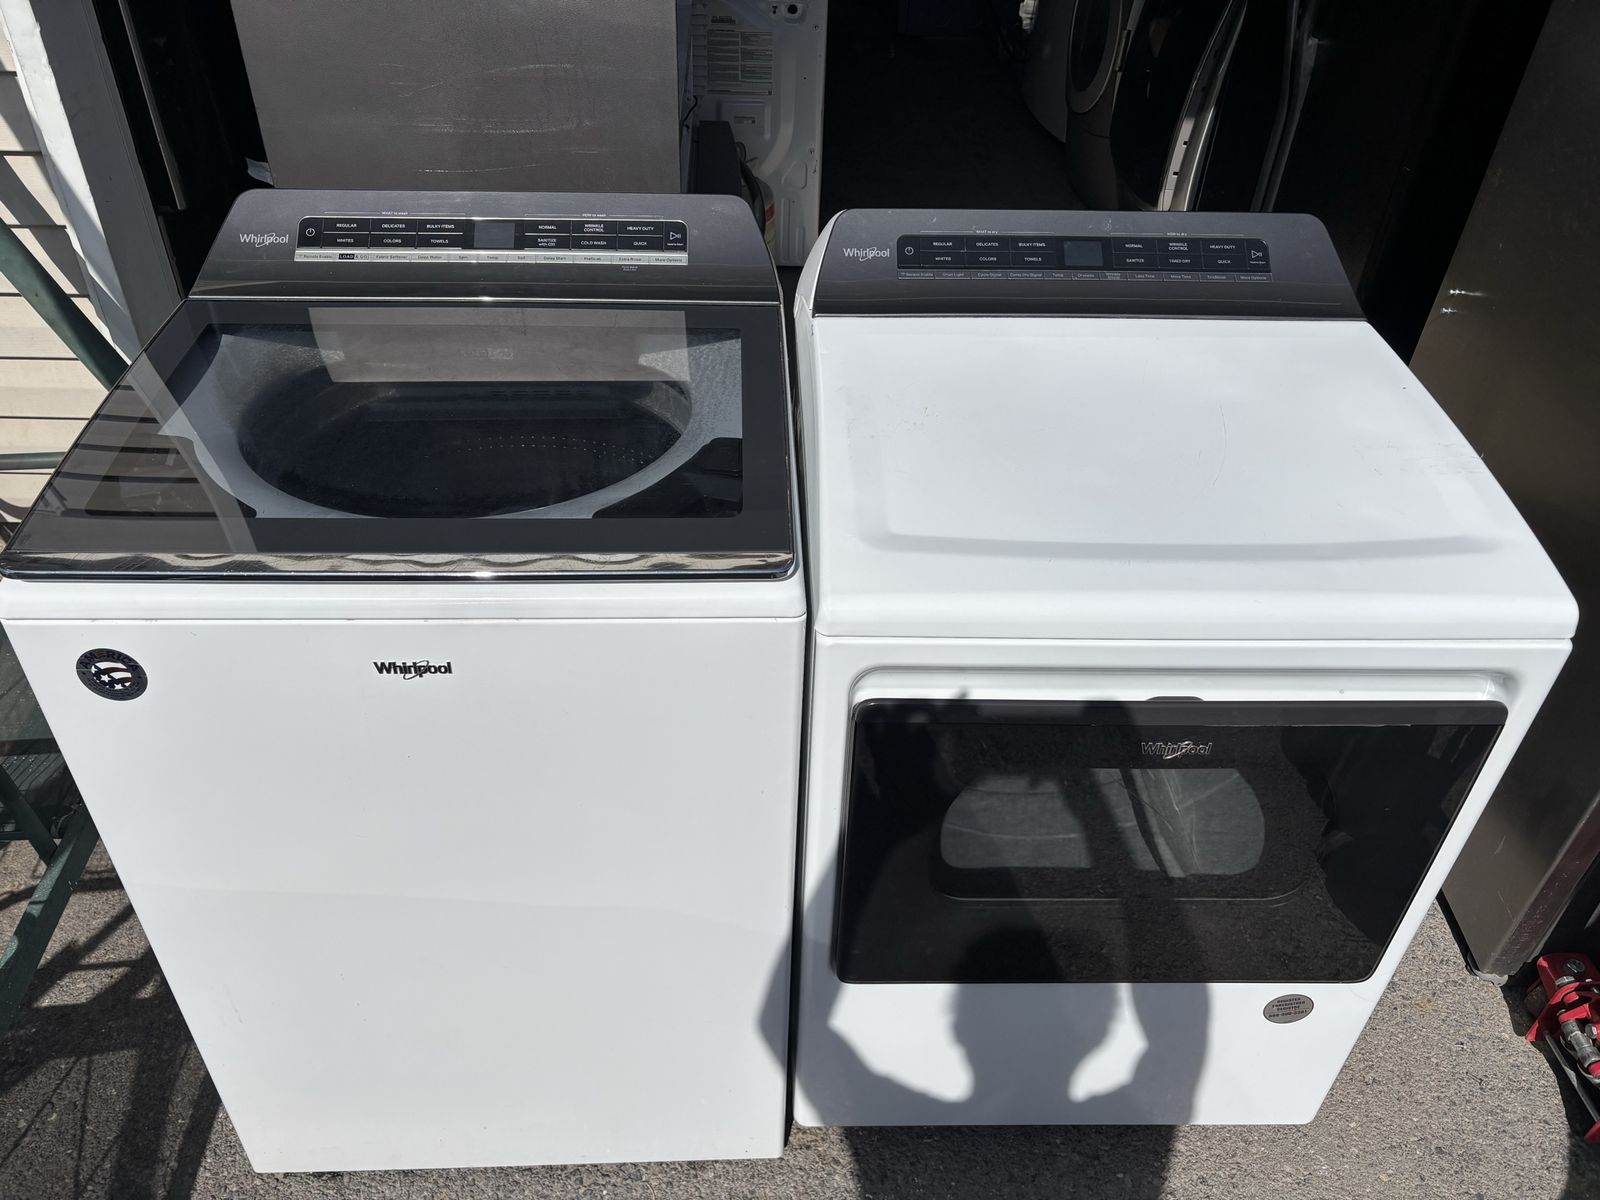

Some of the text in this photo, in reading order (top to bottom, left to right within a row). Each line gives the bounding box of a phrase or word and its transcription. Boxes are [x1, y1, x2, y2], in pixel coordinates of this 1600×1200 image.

[239, 232, 289, 248] Whirlpool
[842, 246, 890, 262] Whirlpool
[372, 659, 453, 681] Whirlpool
[1141, 740, 1213, 760] Whirlpool
